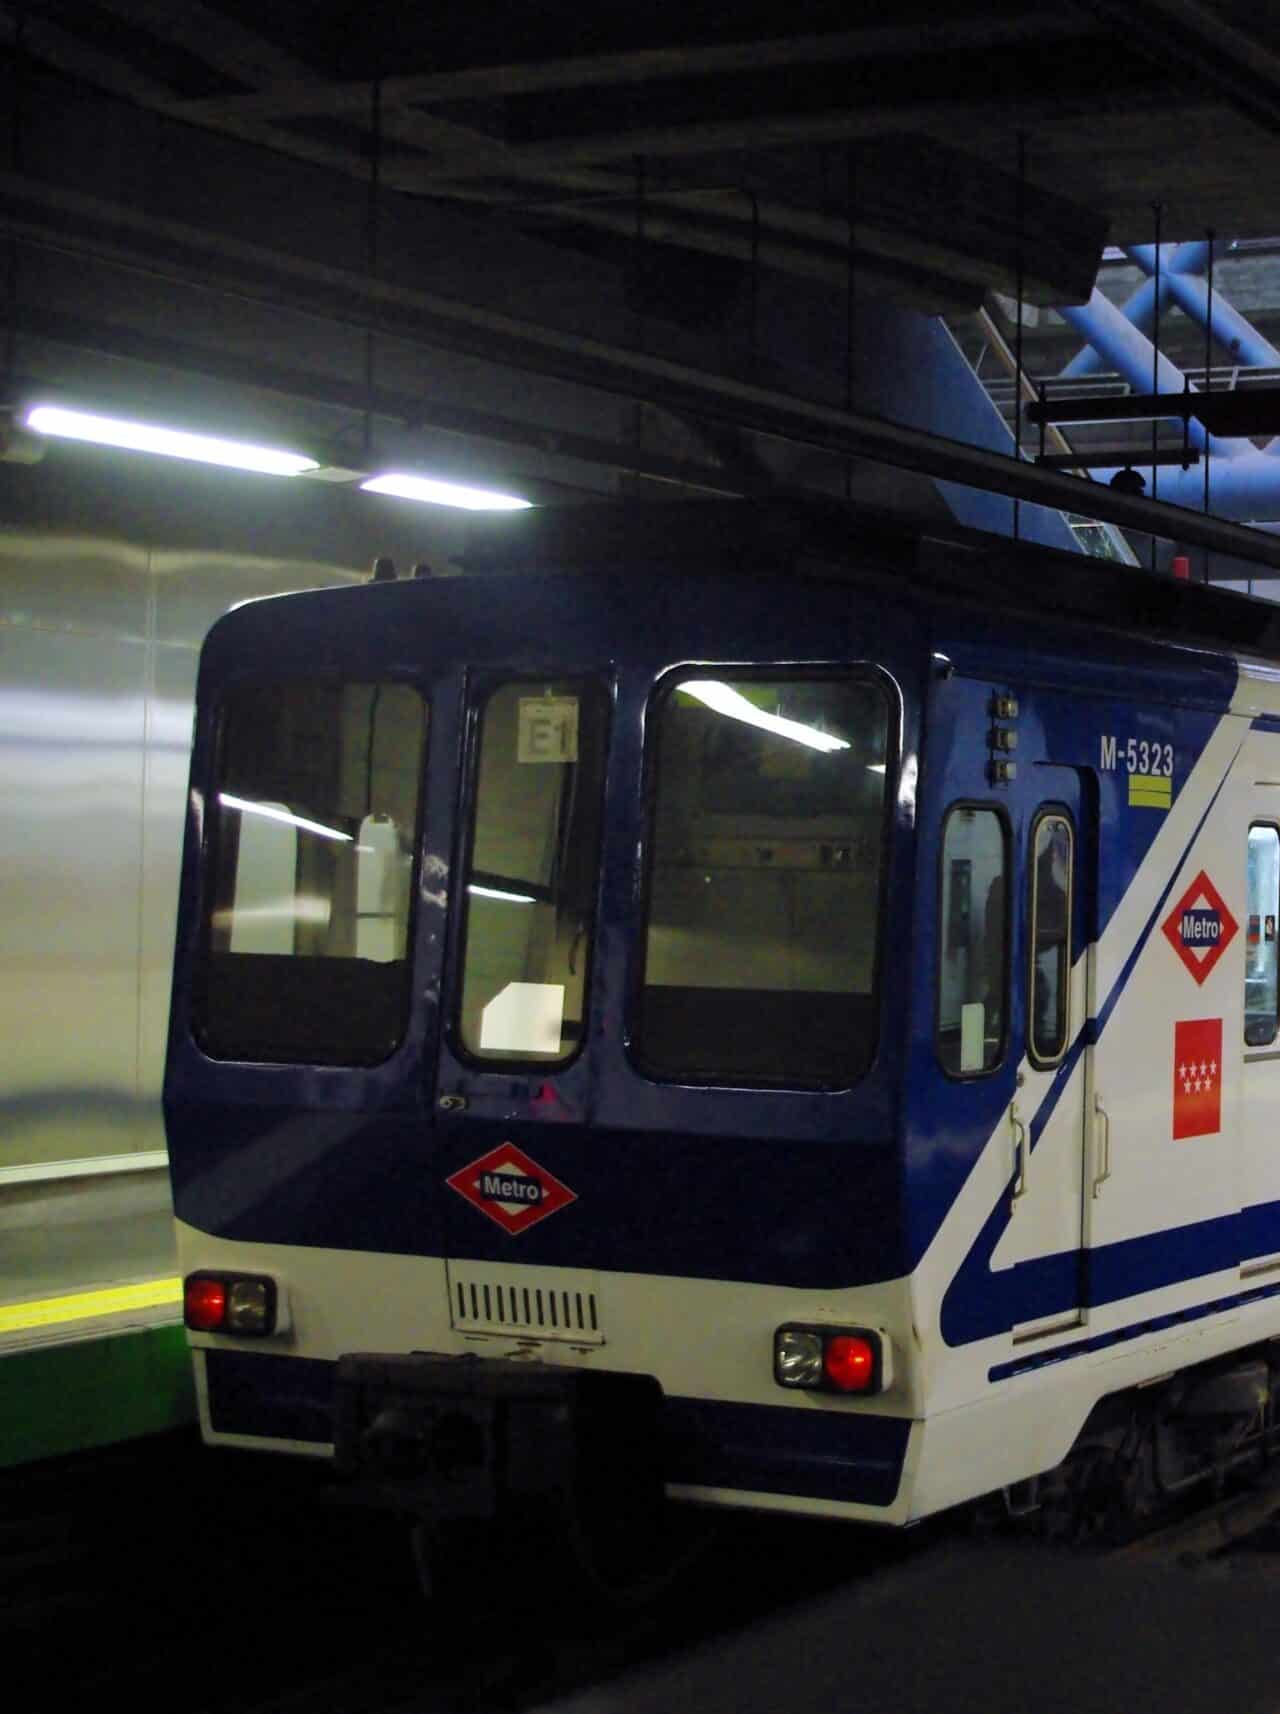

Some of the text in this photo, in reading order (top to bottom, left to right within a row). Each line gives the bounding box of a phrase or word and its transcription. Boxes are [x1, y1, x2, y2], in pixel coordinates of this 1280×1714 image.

[1100, 735, 1174, 777] M-5323
[1183, 914, 1219, 939] Metro
[483, 1175, 540, 1202] Metro
